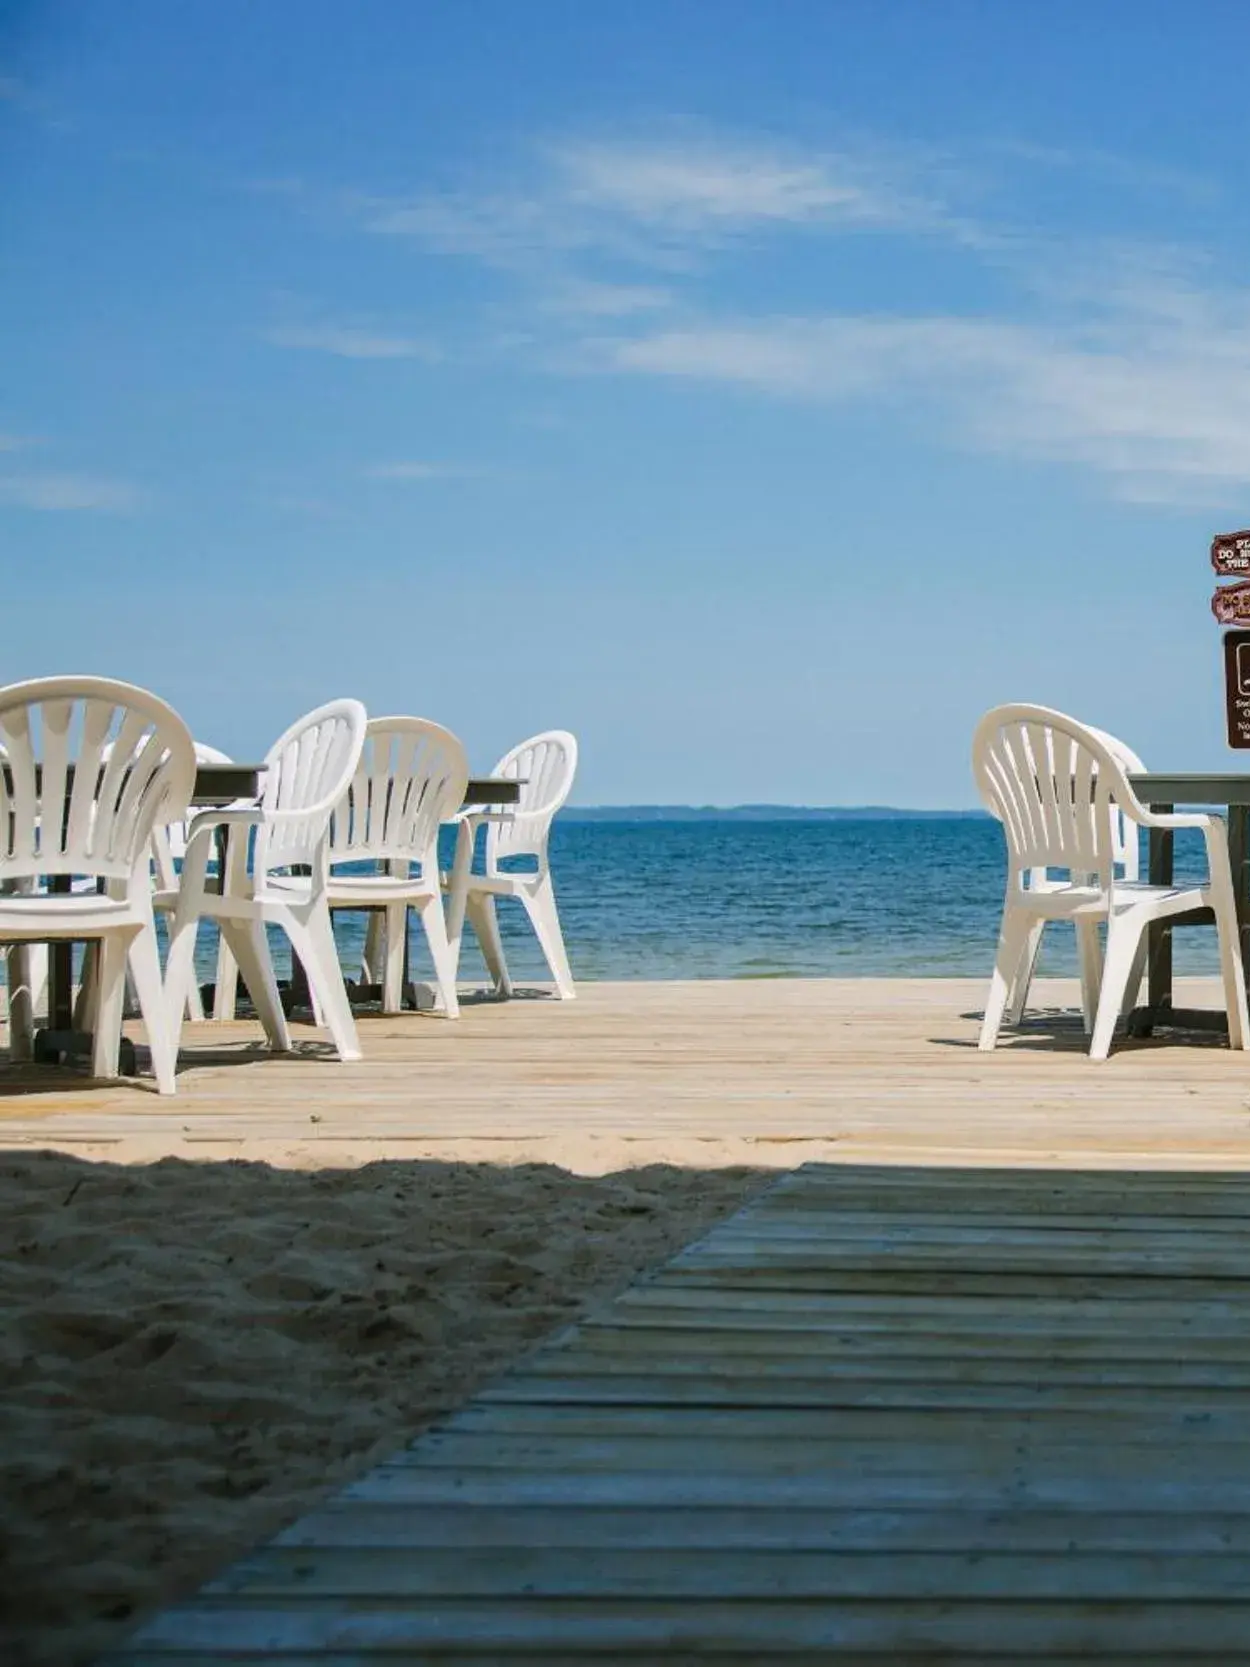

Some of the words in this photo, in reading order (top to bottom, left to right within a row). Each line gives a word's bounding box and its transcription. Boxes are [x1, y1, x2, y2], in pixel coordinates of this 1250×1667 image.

[1218, 549, 1234, 559] DO
[1226, 559, 1249, 568] THE
[1238, 721, 1250, 730] No
